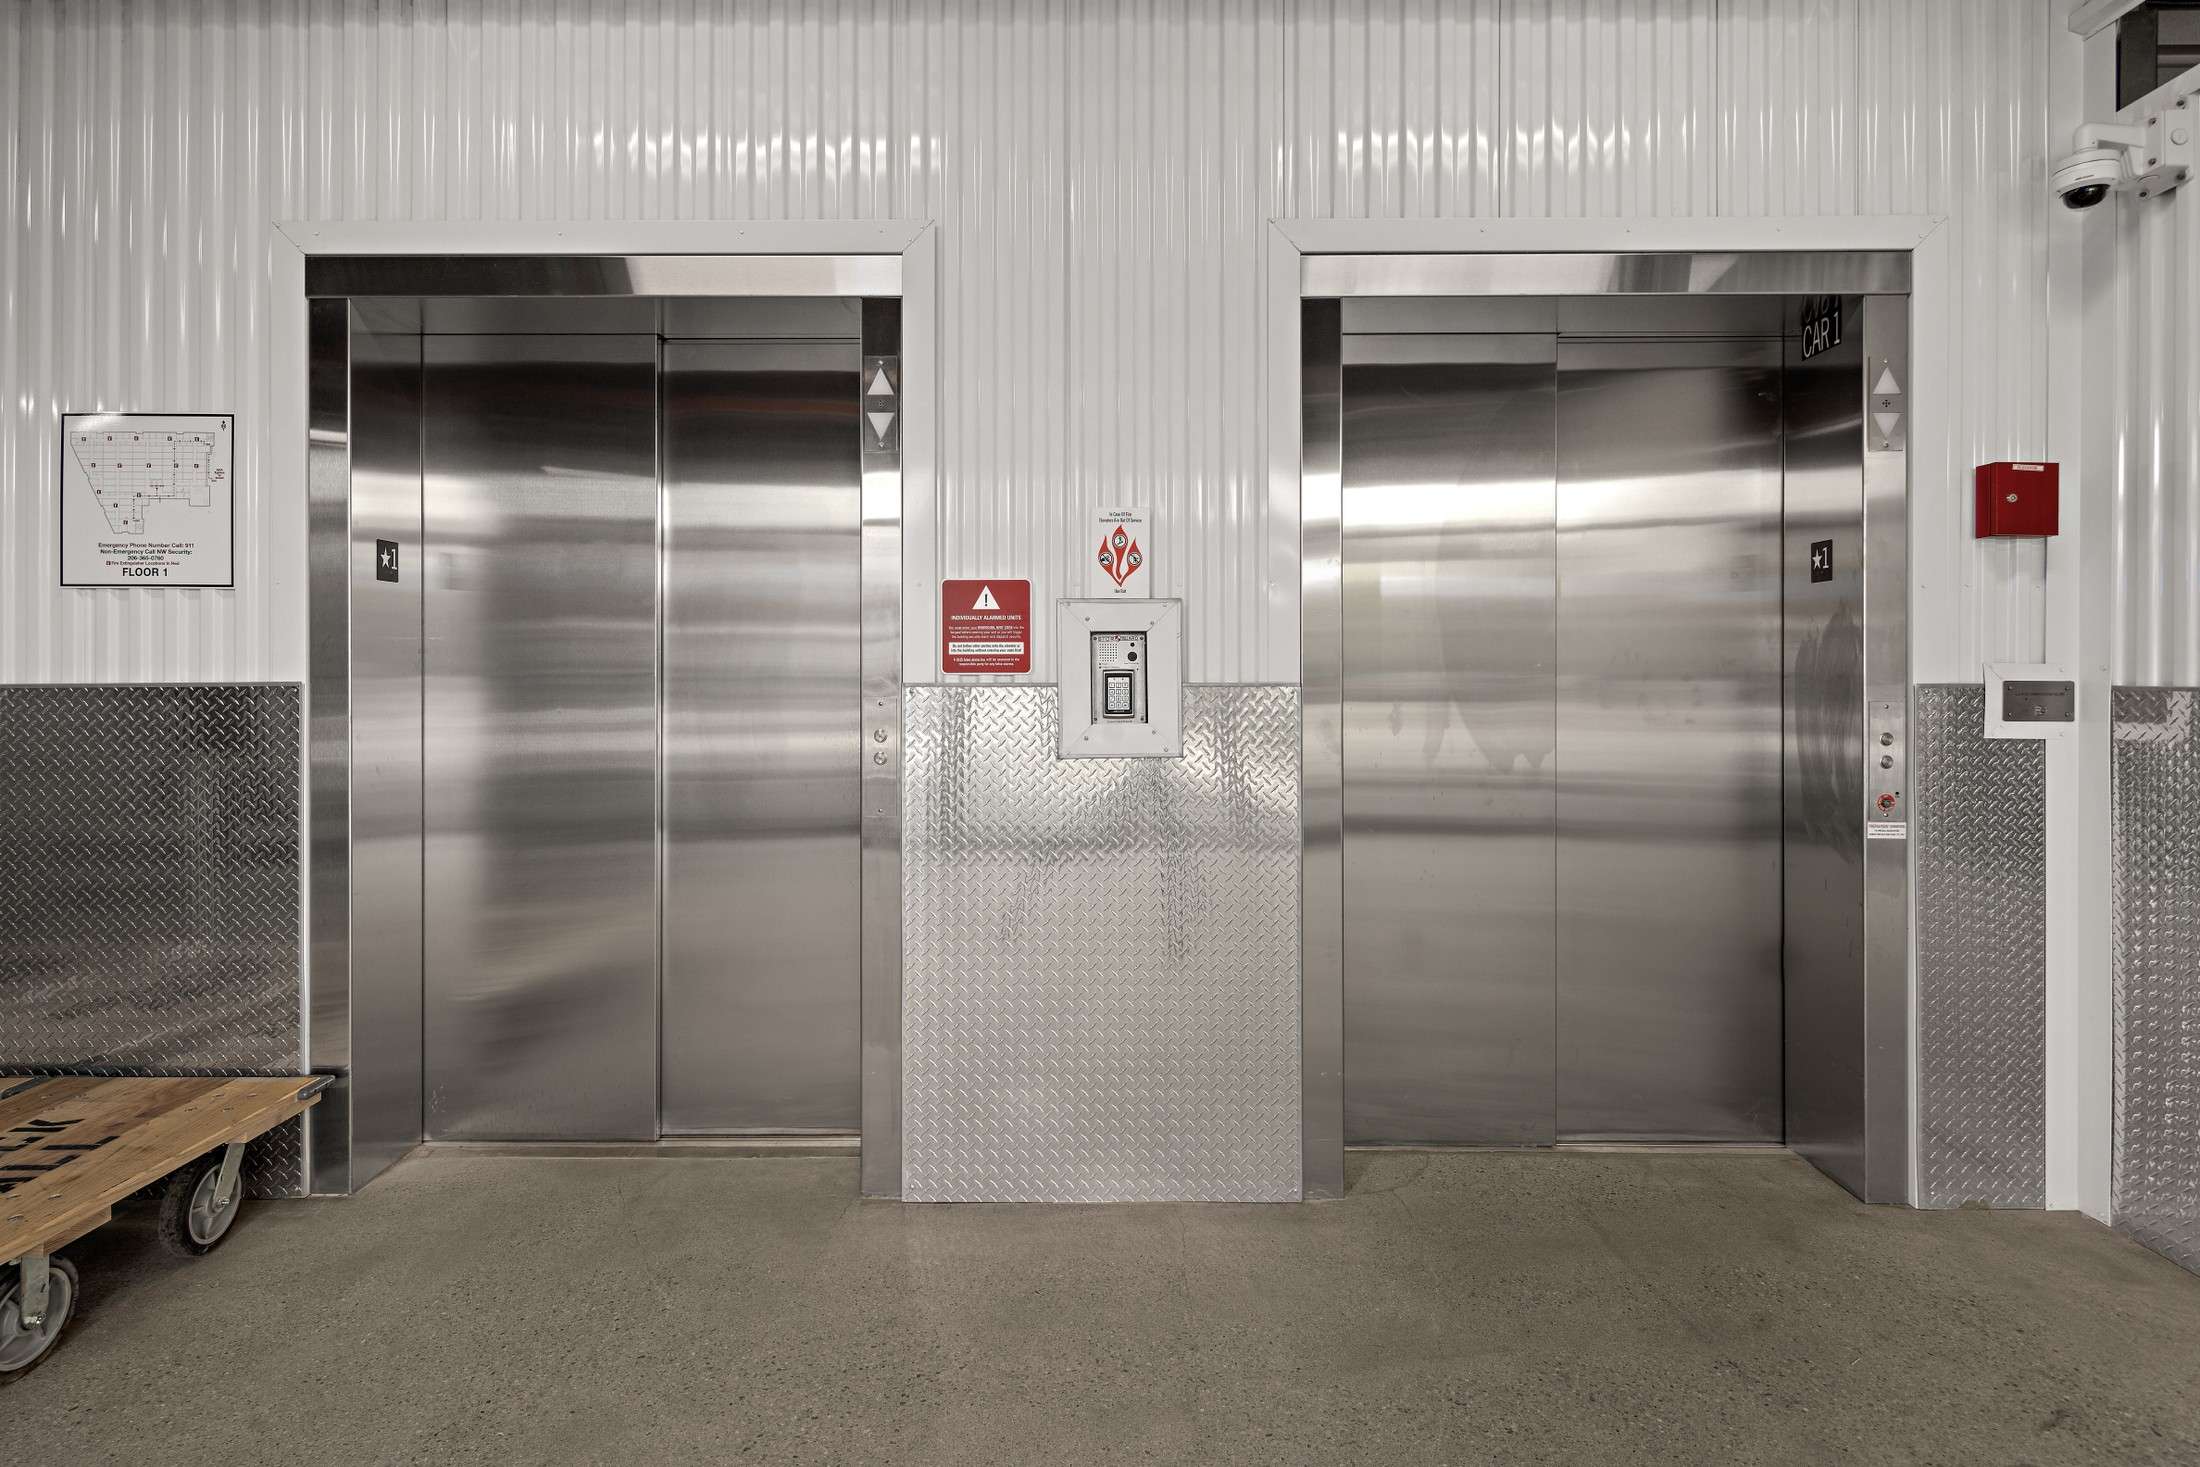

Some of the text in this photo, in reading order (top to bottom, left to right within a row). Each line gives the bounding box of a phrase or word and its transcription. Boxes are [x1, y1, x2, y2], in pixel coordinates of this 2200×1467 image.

[1803, 311, 1840, 358] CAR 1
[391, 548, 397, 570] 1
[1822, 547, 1829, 569] 1
[122, 568, 168, 577] FLOOR 1
